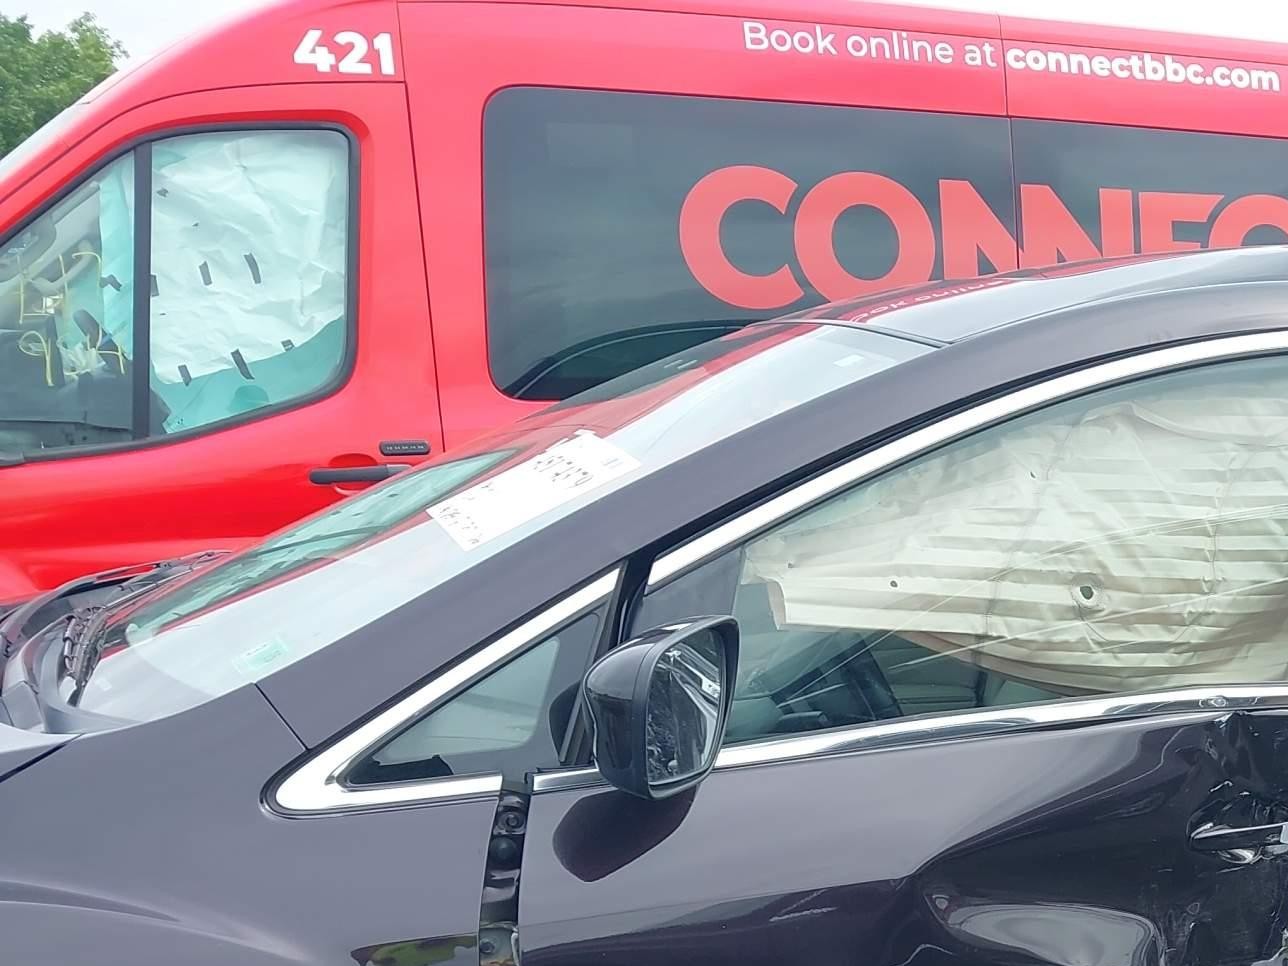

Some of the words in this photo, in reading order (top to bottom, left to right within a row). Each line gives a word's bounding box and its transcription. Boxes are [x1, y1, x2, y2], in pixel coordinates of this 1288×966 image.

[292, 28, 396, 76] 421
[742, 21, 838, 56] Book
[846, 31, 954, 64] online
[964, 41, 998, 68] at
[1005, 47, 1281, 92] connectbbc.com
